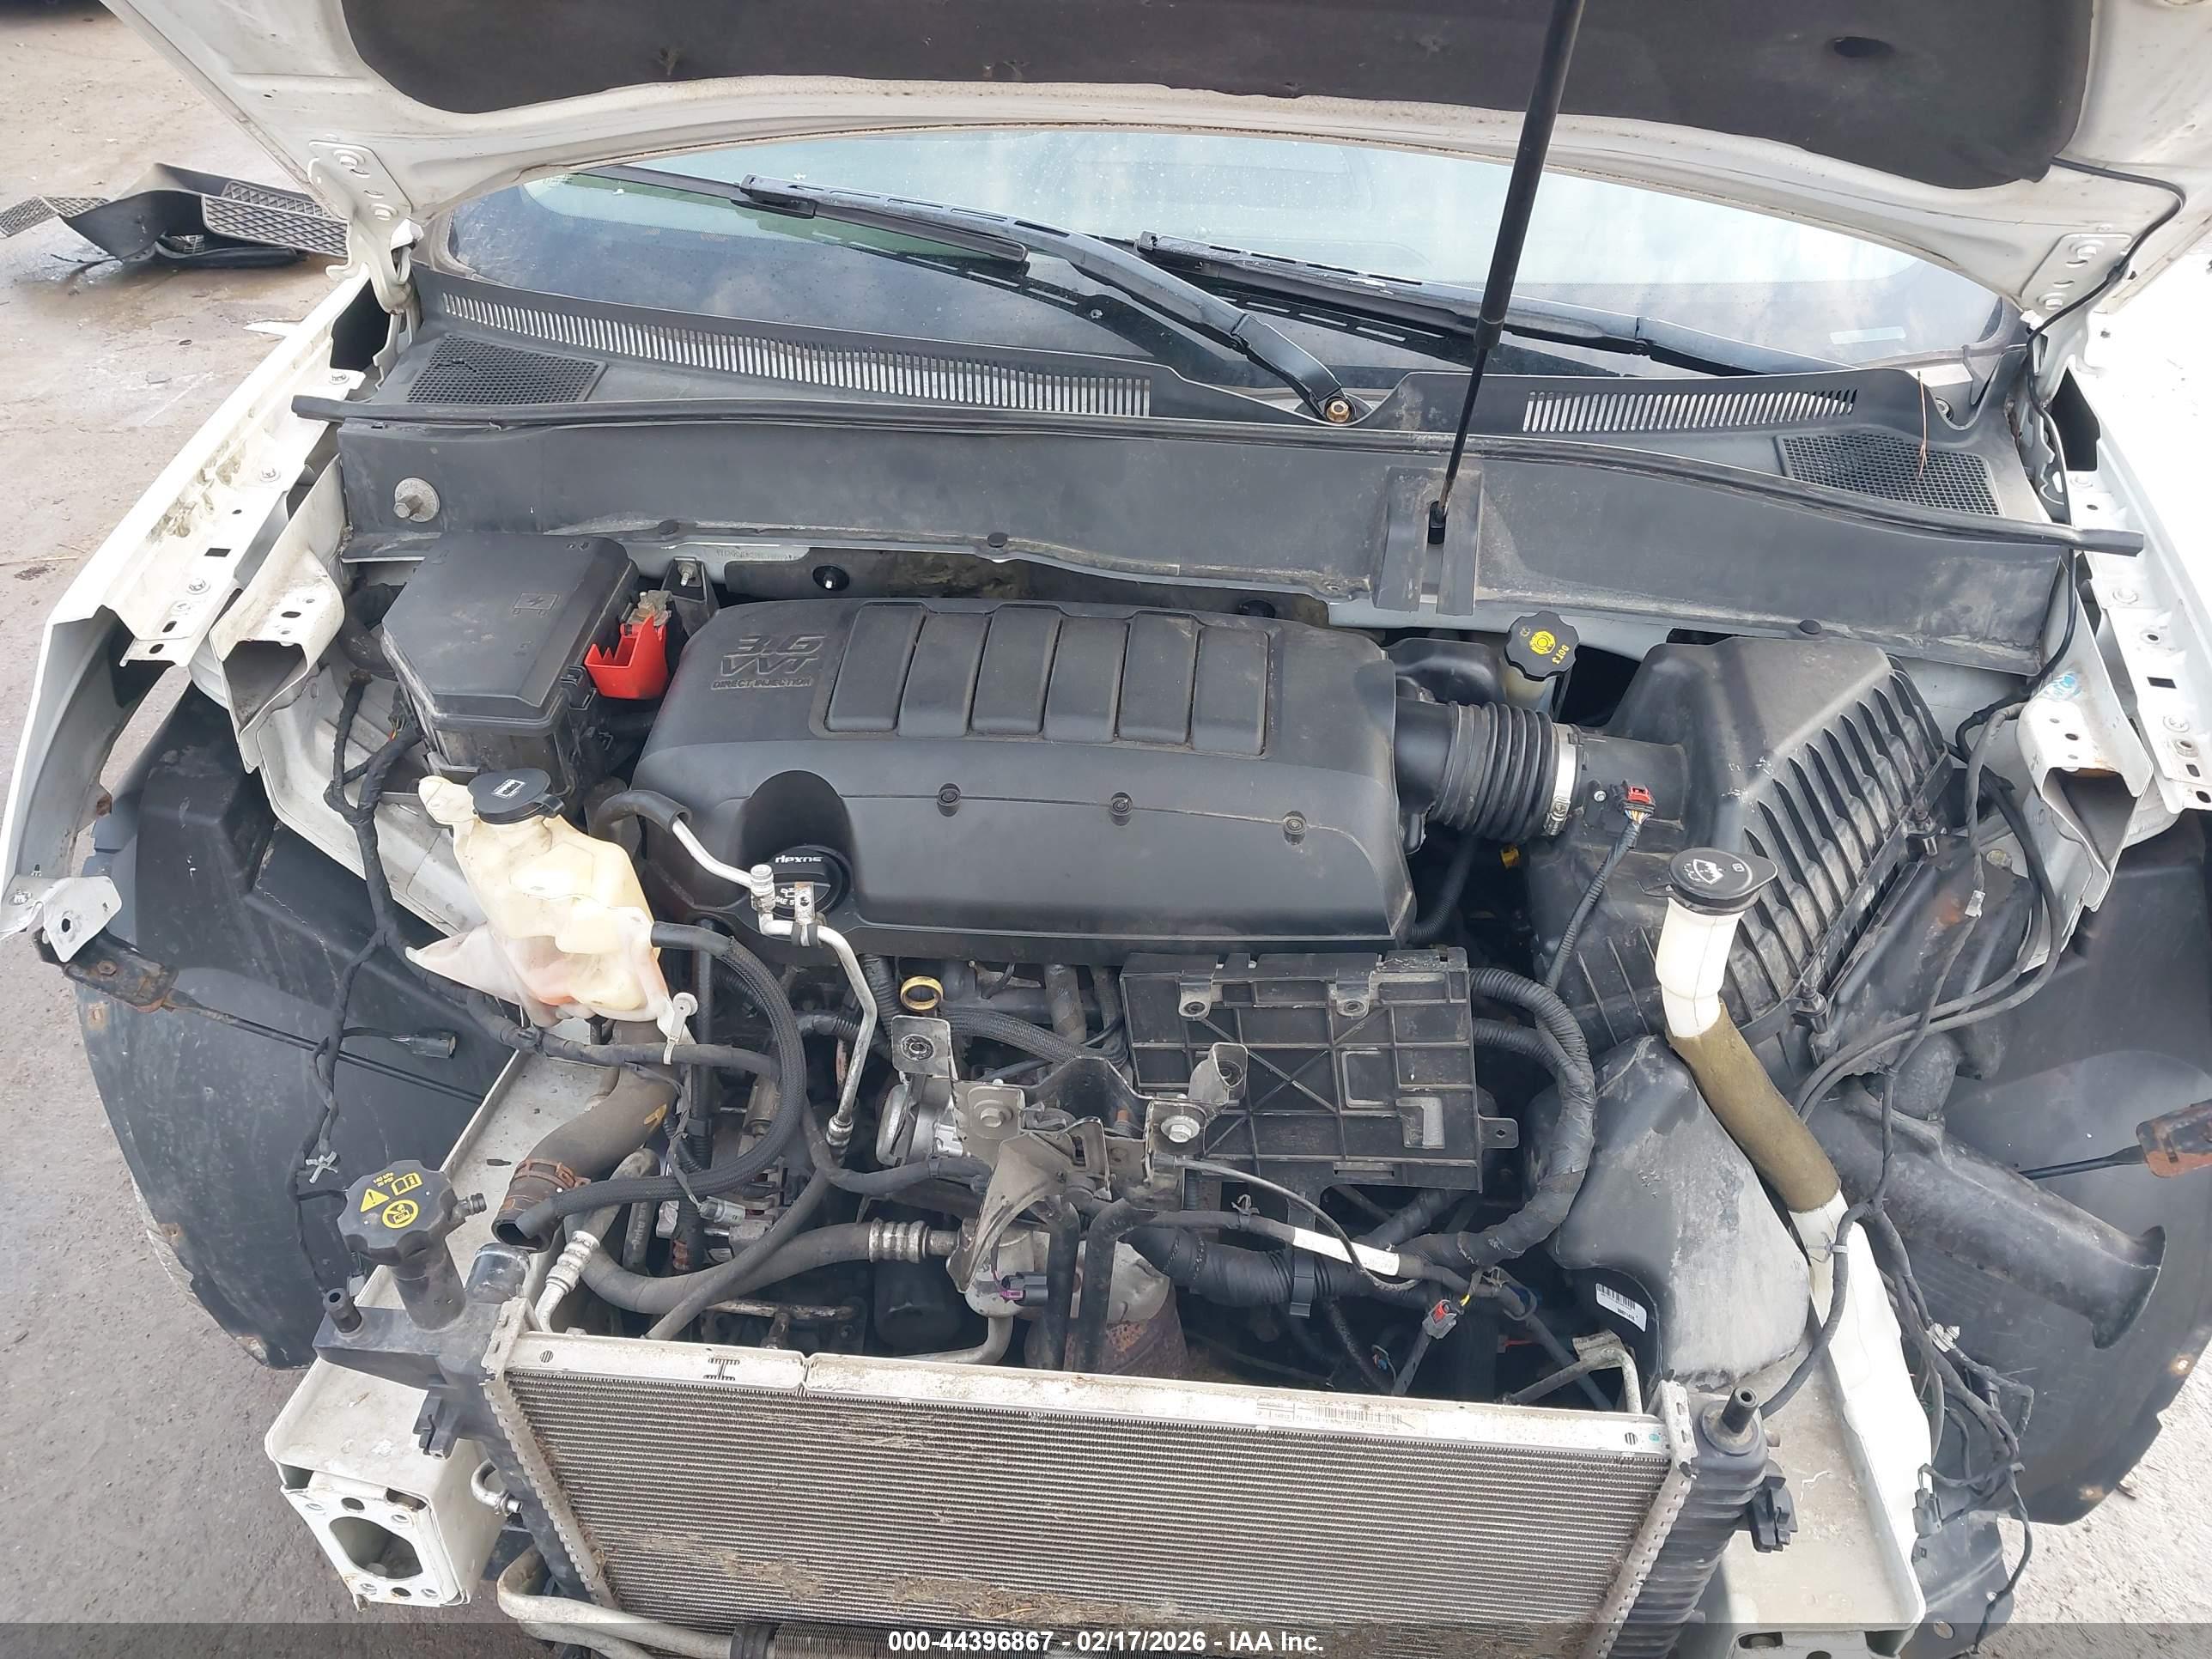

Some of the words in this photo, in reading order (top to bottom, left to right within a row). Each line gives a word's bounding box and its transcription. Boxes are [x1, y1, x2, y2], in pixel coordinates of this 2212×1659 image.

[724, 634, 826, 657] 3.6
[720, 656, 819, 677] VVT
[711, 679, 754, 690] DIRECT
[755, 678, 811, 688] INJECTION
[775, 896, 788, 905] SAE
